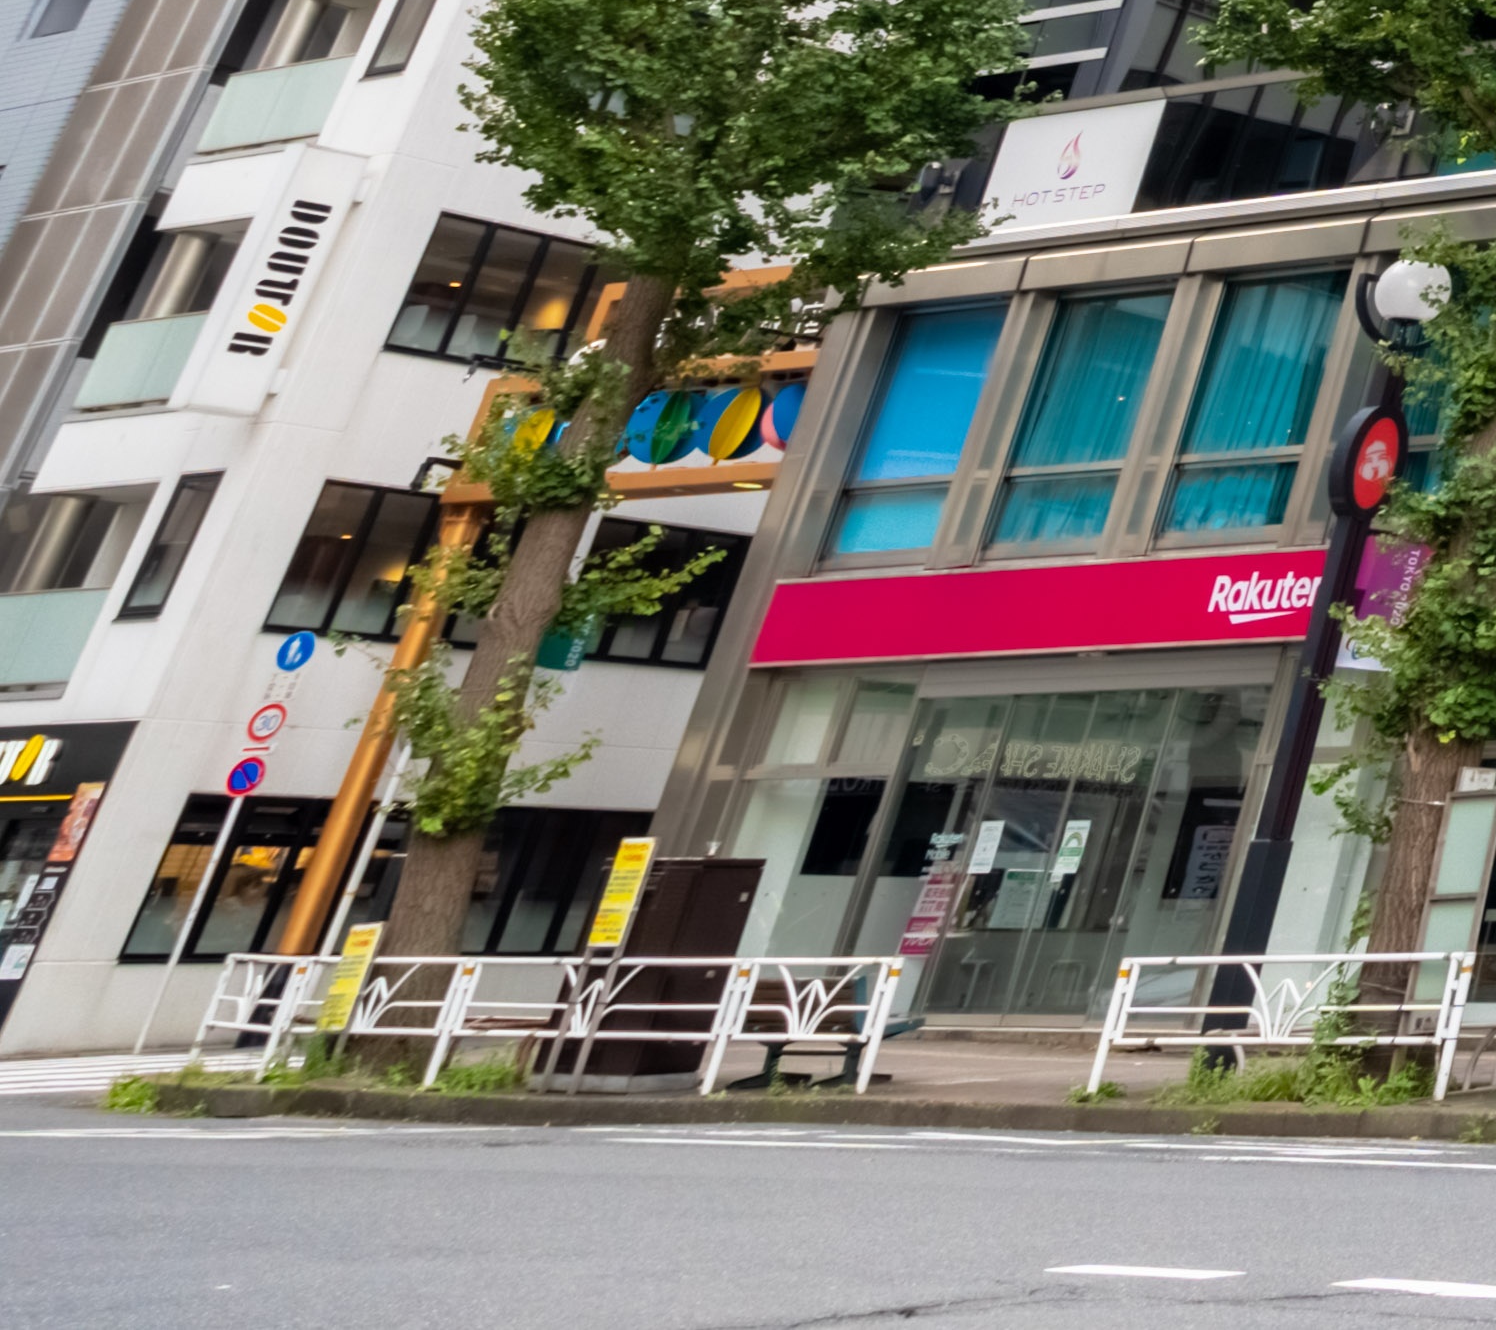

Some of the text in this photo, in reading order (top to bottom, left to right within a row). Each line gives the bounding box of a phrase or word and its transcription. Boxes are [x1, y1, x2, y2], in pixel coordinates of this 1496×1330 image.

[227, 199, 333, 357] DOUTOR
[1399, 548, 1421, 592] TOKYO
[255, 714, 280, 732] 30
